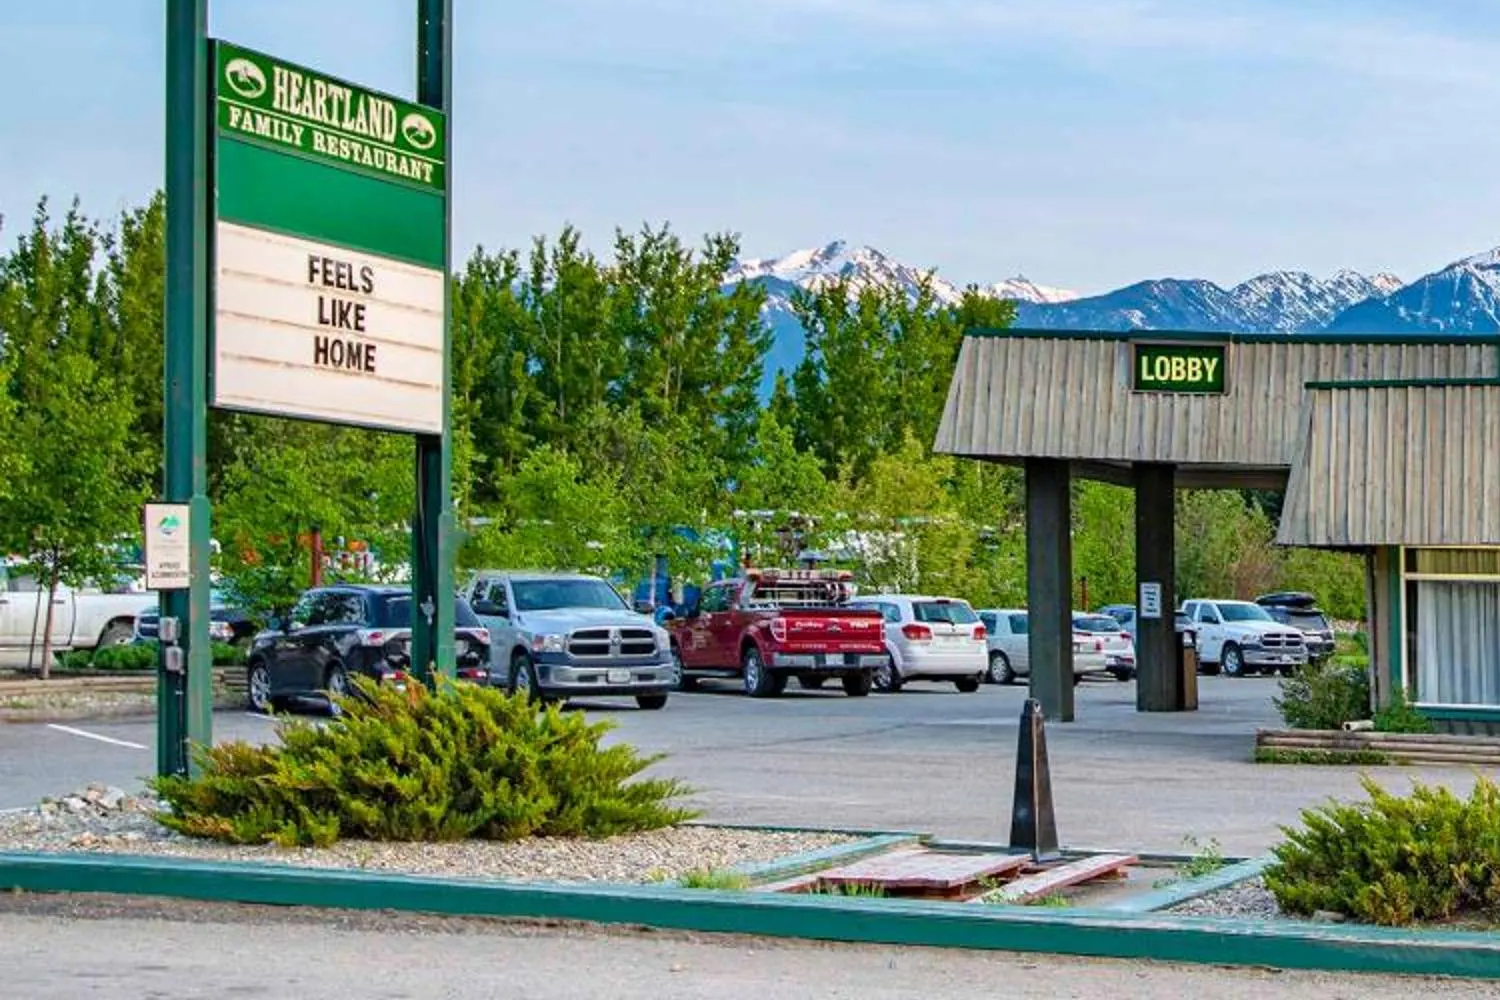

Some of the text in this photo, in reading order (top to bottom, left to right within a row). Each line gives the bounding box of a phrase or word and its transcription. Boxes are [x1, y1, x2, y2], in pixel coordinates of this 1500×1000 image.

[272, 65, 397, 144] HEARTLAND
[229, 105, 433, 183] FAMILY RESTAURANT
[308, 254, 374, 294] FEELS
[318, 295, 366, 332] LIKE
[314, 335, 376, 373] HOME
[1141, 356, 1219, 383] LOBBY
